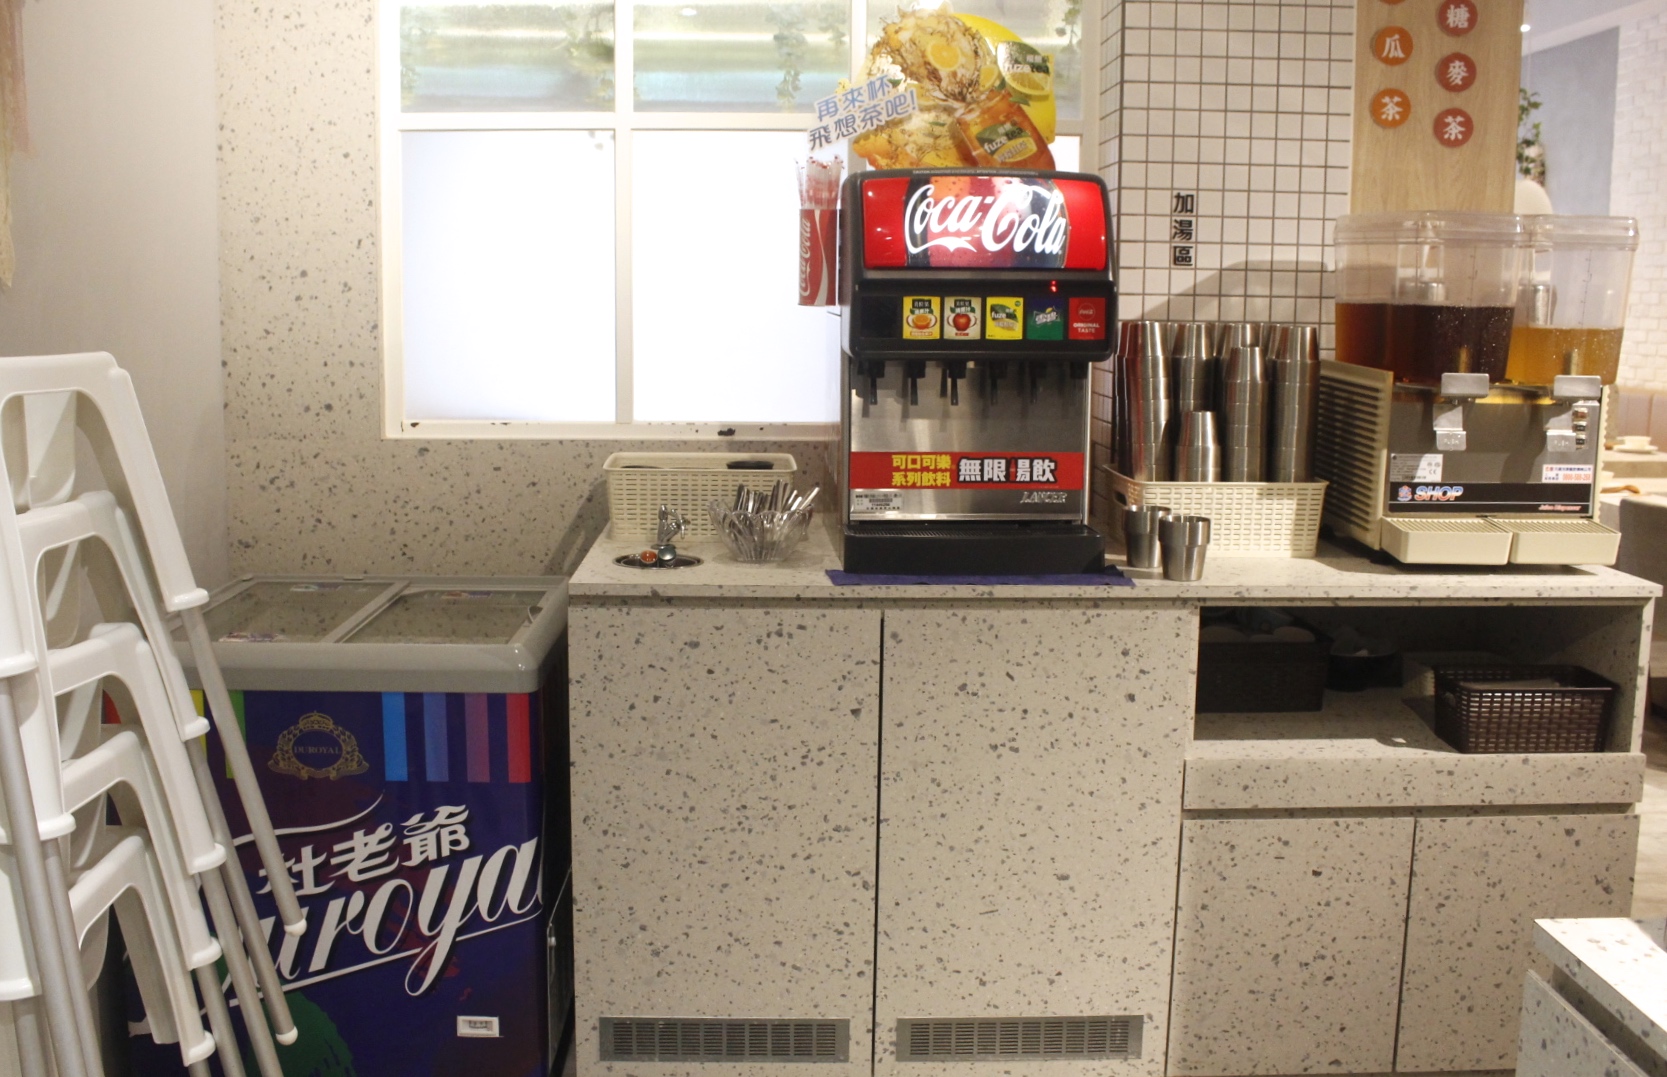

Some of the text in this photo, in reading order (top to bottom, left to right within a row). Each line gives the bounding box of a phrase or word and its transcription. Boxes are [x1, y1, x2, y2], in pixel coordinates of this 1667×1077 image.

[816, 75, 890, 122] 再來杯
[1379, 34, 1405, 122] 瓜茶
[809, 89, 917, 151] 飛想茶吧!
[904, 184, 1067, 255] Coca-Cola
[1172, 192, 1194, 266] 加湯區
[892, 454, 951, 469] 可口可樂
[892, 471, 951, 487] 系列飲料
[1414, 485, 1464, 501] SHOP
[256, 804, 471, 897] 杜老爺
[200, 836, 543, 998] uroya
